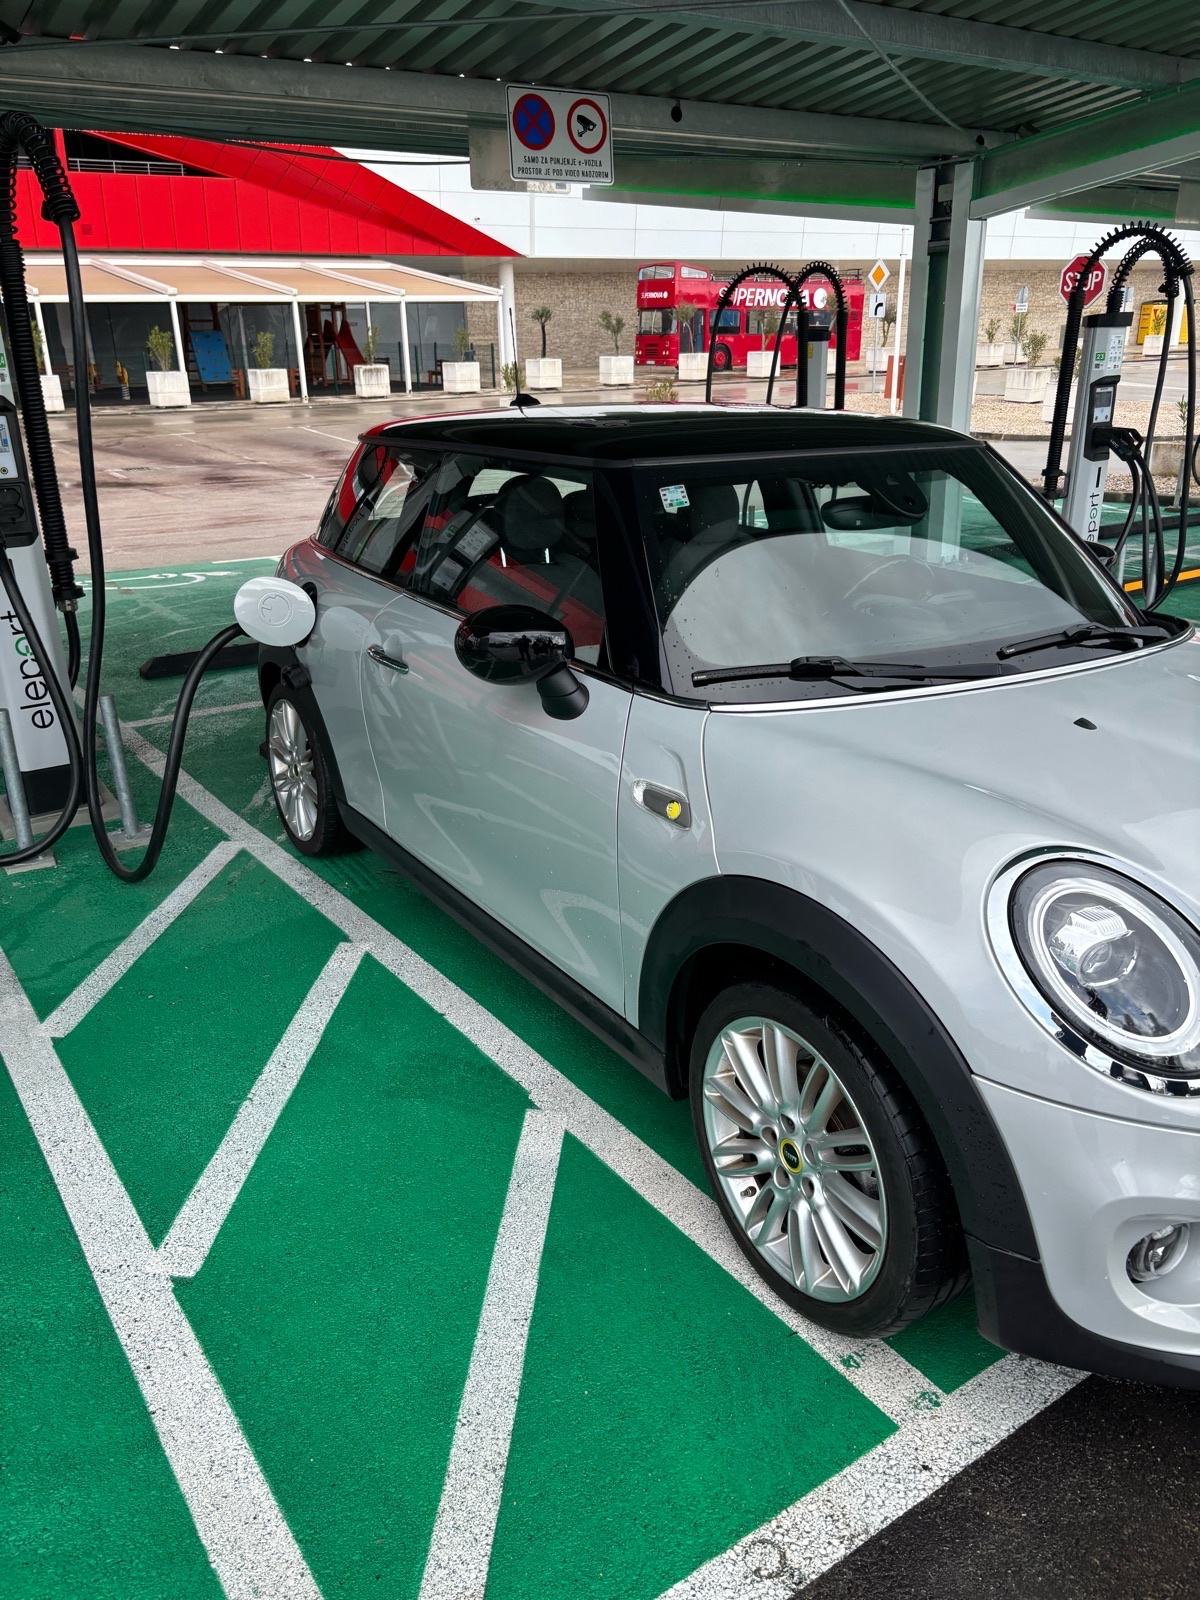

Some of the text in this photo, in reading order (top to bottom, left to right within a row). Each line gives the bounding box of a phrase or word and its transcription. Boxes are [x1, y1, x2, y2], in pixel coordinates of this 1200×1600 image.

[523, 155, 603, 167] SAMO ZA PUNJENJE e-VOZILA
[517, 166, 609, 179] PROSTOR JE POD VIDEO NADZOROM
[718, 286, 810, 307] SPERNOA
